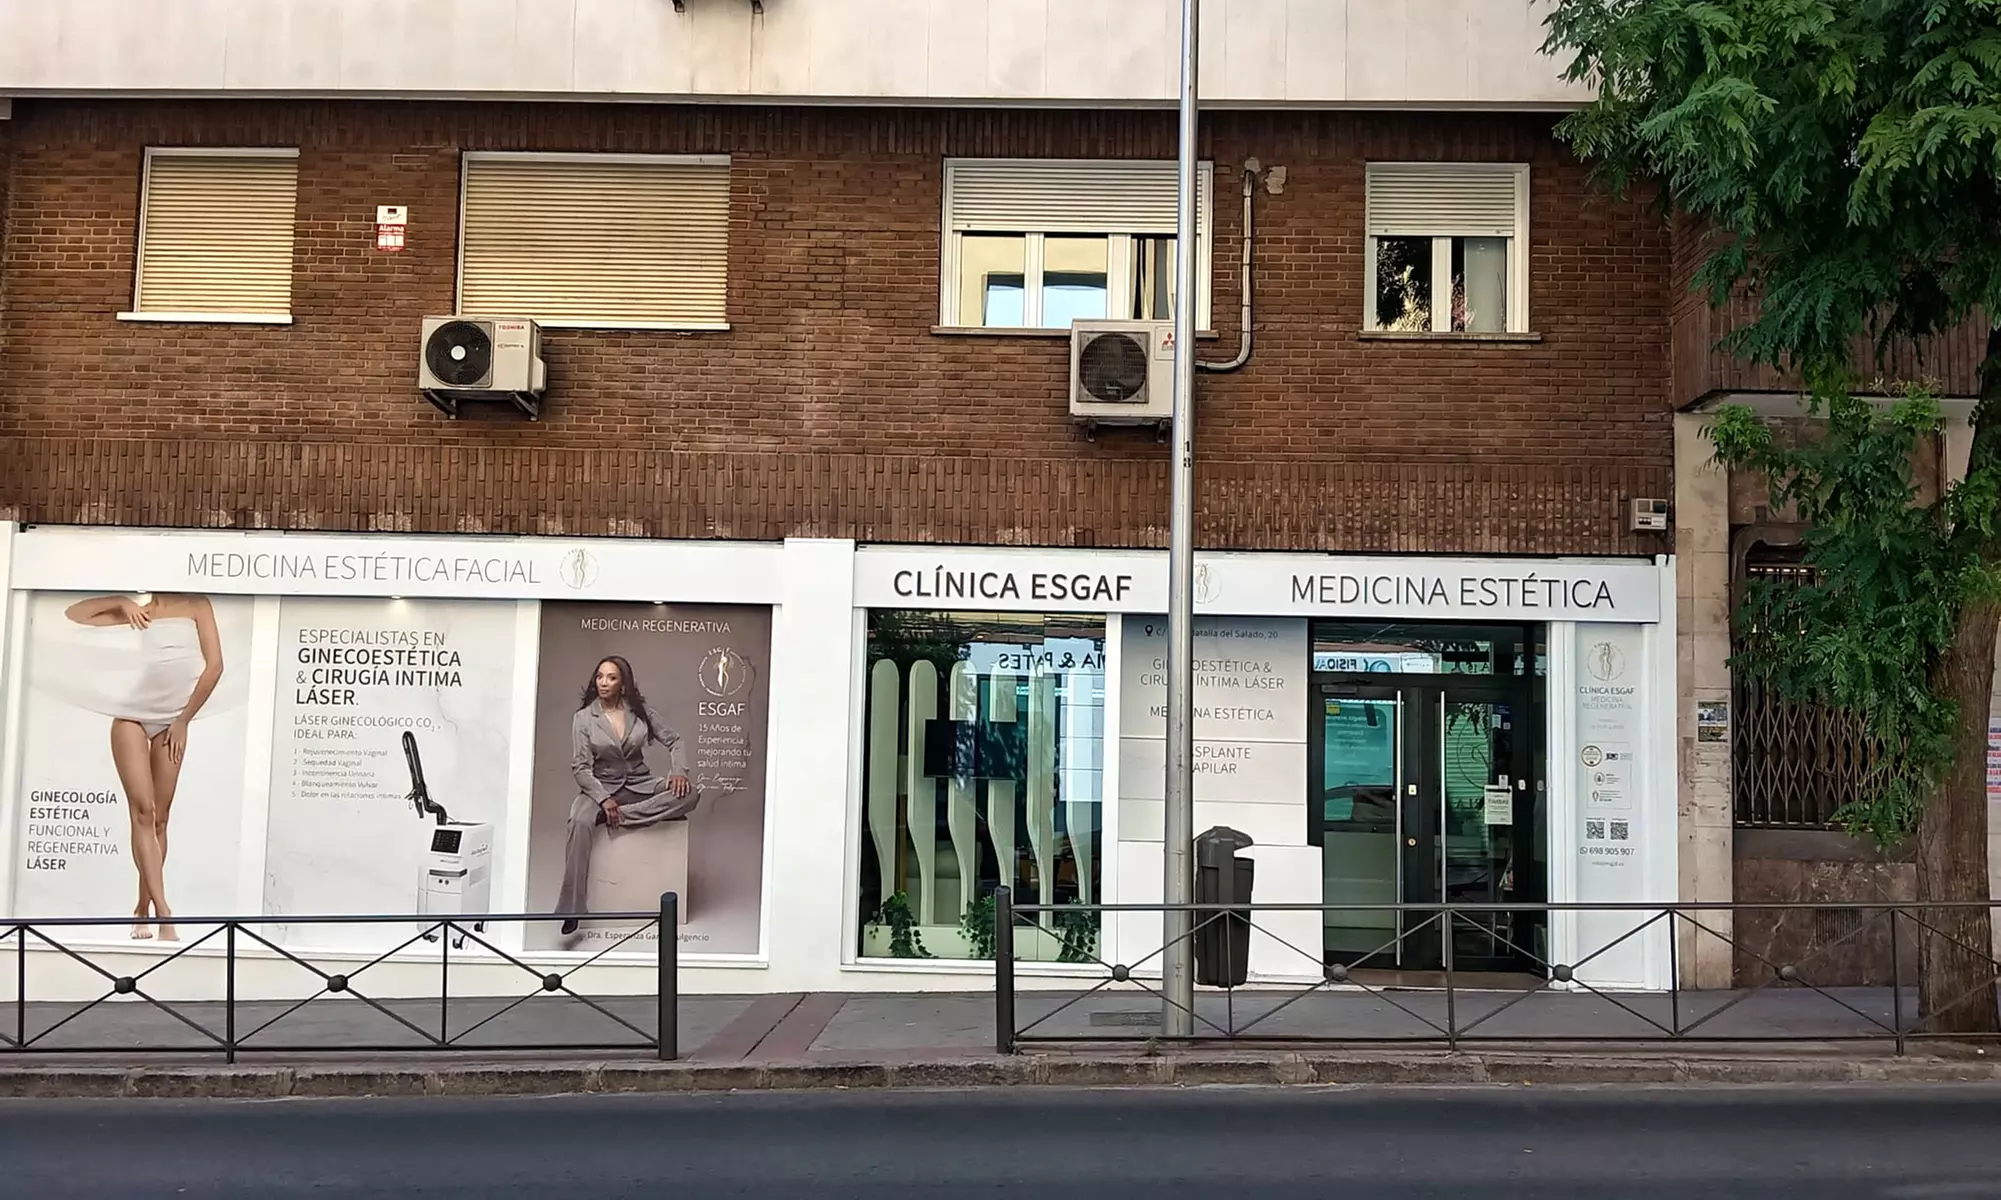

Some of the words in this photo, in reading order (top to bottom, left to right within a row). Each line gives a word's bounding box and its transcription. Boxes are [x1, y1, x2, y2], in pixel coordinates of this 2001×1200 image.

[188, 553, 316, 579] MEDICINA
[325, 551, 449, 582] ESTÉTICA
[454, 558, 541, 584] FACIAL
[893, 564, 1020, 599] CLÍNICA
[1031, 574, 1131, 601] ESGAF
[1292, 575, 1449, 605] MEDICINA
[1460, 572, 1615, 609] ESTÉTICA
[581, 618, 639, 631] MEDICINA
[642, 620, 731, 633] REGENERATIVA
[299, 629, 419, 646] ESPECIALISTAS
[423, 632, 445, 646] EN
[1220, 630, 1233, 638] del
[1235, 630, 1266, 639] Salado,
[1268, 631, 1278, 639] 20
[298, 646, 462, 667] GINECOESTÉTICA
[1263, 662, 1272, 673] &
[296, 670, 307, 684] &
[312, 666, 390, 686] CIRUGÍA
[395, 670, 462, 687] INTIMA
[1196, 675, 1240, 688] ÍNTIMA
[1245, 677, 1285, 689] LÁSER
[296, 685, 359, 706] LÁSER.
[1580, 686, 1609, 694] CLÍNICA
[1611, 687, 1634, 695] ESGAF
[699, 702, 745, 717] ESGAF
[1215, 707, 1274, 721] ESTÉTICA
[294, 714, 328, 726] LÁSER
[331, 715, 413, 728] GINECOLÓGICO
[294, 728, 324, 739] IDEAL
[327, 730, 357, 740] PARA:
[699, 724, 708, 732] 15
[731, 724, 742, 733] de
[698, 735, 744, 745] Experiencia
[698, 748, 742, 758] mejorando
[743, 748, 752, 756] tu
[697, 759, 719, 768] salud
[1193, 763, 1237, 776] APILAR
[30, 790, 118, 804] GINECOLOGÍA
[29, 806, 90, 820] ESTÉTICA
[28, 824, 100, 838] FUNCIONAL
[103, 826, 111, 837] Y
[27, 841, 119, 855] REGENERATIVA
[1604, 847, 1619, 855] 905
[1620, 848, 1634, 856] 907
[27, 856, 67, 870] LÁSER
[587, 931, 602, 939] Dra.
